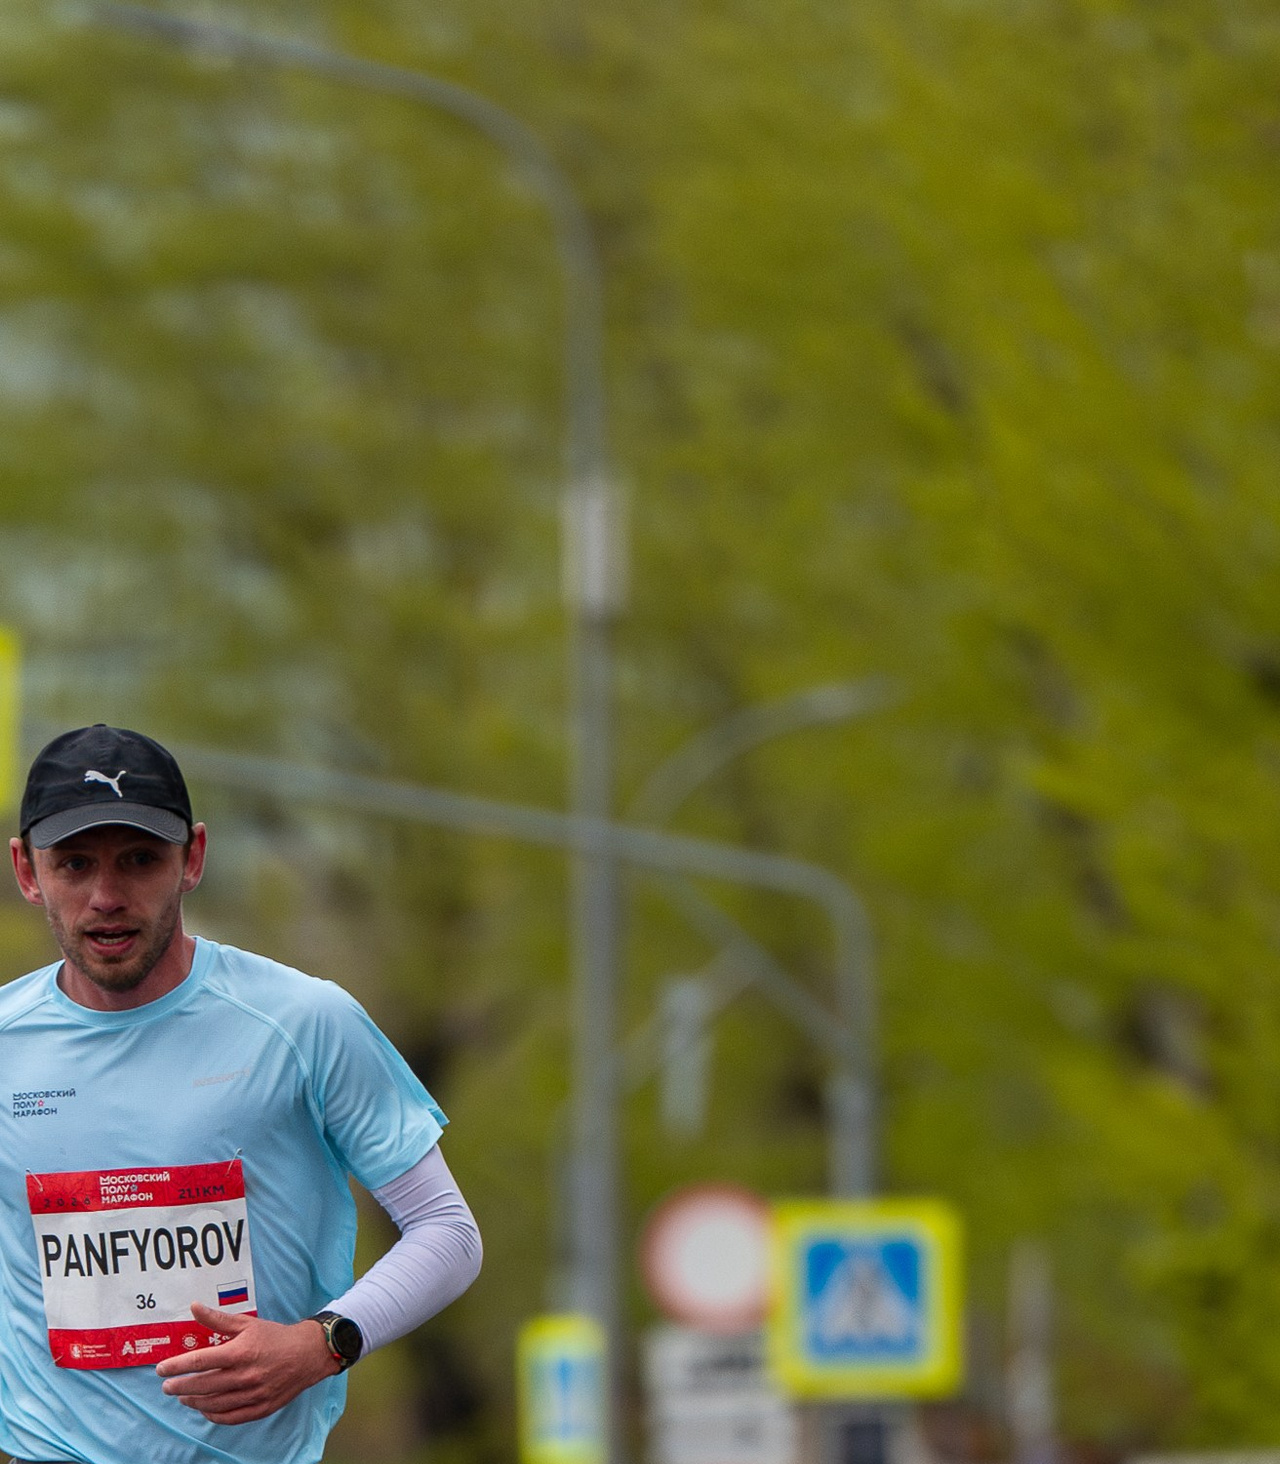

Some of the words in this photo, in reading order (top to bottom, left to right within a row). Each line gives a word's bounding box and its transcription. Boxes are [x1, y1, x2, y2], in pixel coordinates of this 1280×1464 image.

[13, 1088, 76, 1101] МОСКОВСКИЙ
[13, 1101, 37, 1109] ПОЛУ
[13, 1108, 57, 1118] МАРАФОН
[100, 1171, 170, 1185] МОСКОВСКИЙ
[100, 1184, 130, 1195] ПОЛУ
[101, 1192, 154, 1204] МАРАФОН
[41, 1218, 245, 1278] PANFYOROV
[136, 1294, 157, 1310] 36
